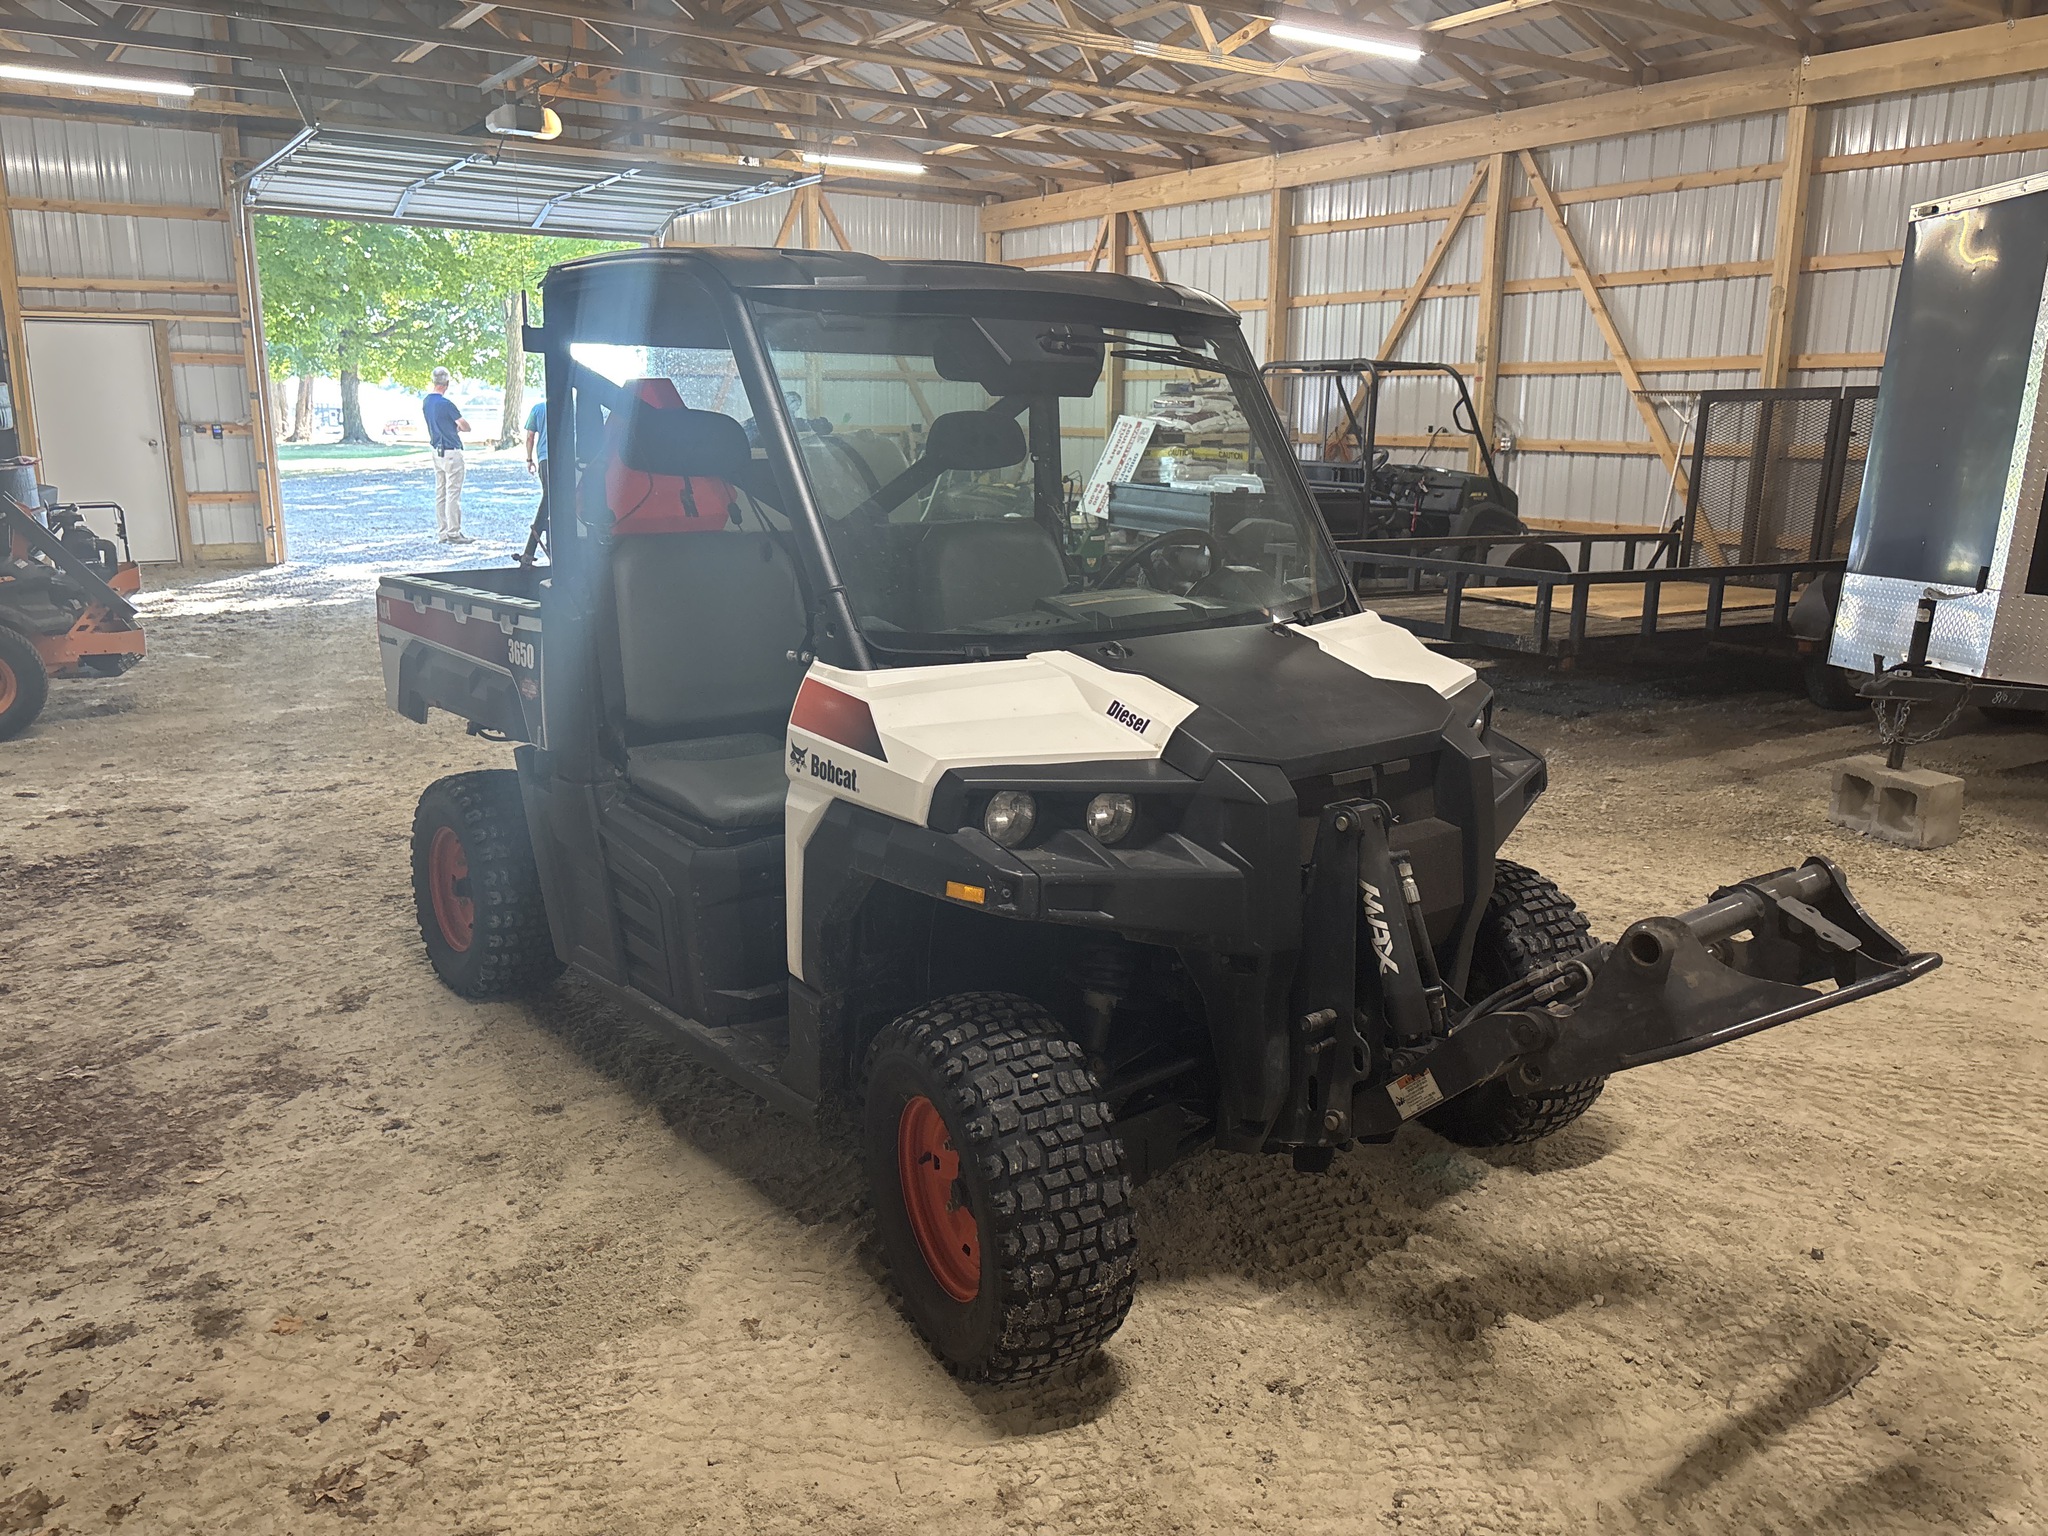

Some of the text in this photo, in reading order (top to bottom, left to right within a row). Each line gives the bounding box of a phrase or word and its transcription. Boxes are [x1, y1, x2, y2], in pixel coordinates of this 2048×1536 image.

[1106, 422, 1128, 465] STUDENTS
[1115, 423, 1133, 455] ADULTS
[1168, 448, 1195, 457] CAUTION
[1218, 450, 1243, 460] CAUTION
[508, 638, 535, 669] 3650
[1106, 699, 1151, 734] Diesel
[811, 753, 857, 792] Bobcat
[1359, 879, 1399, 976] MAX
